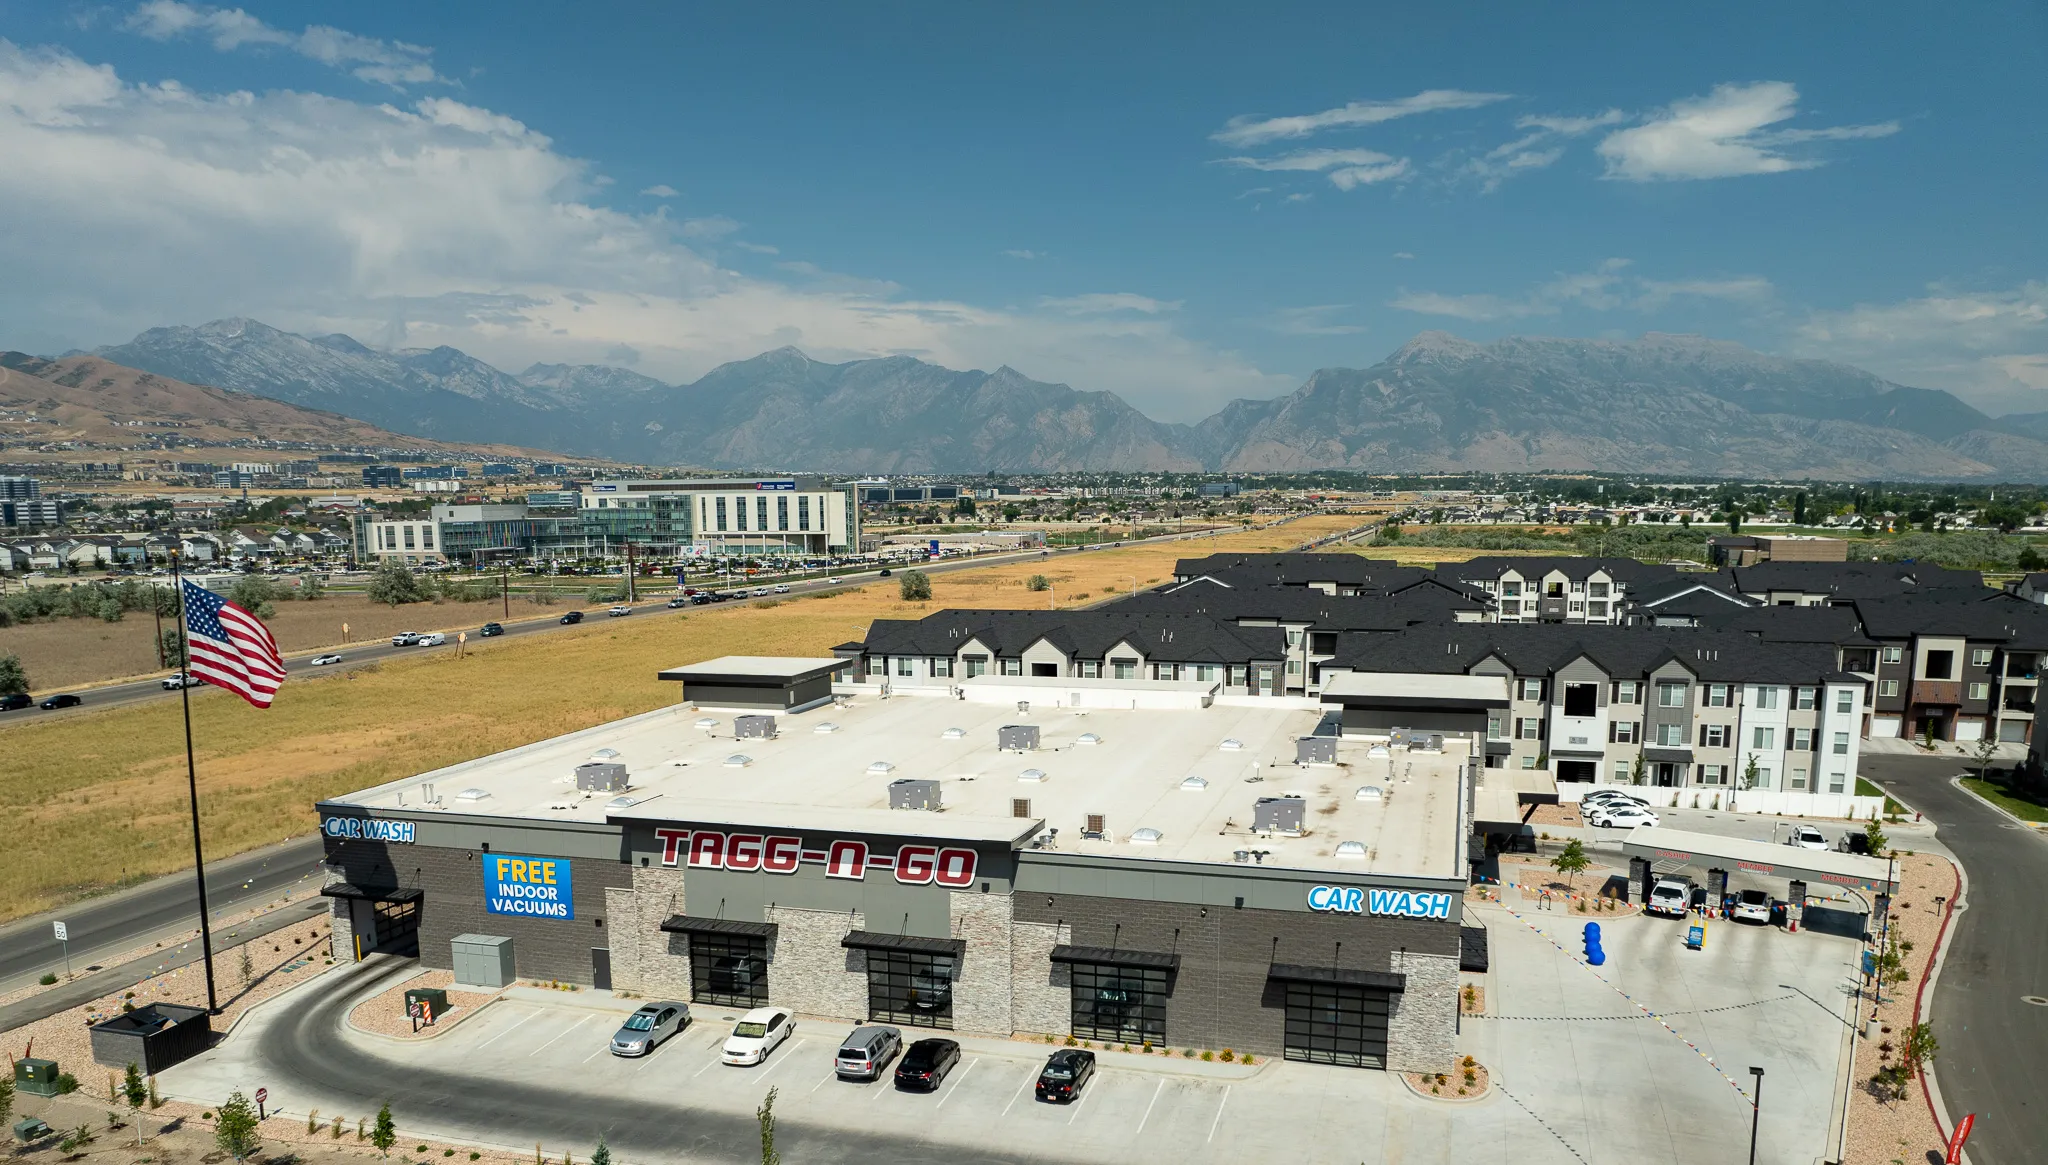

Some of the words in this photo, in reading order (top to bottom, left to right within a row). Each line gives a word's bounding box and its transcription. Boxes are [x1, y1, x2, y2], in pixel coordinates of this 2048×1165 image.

[326, 817, 361, 839] CAR
[362, 819, 416, 843] WASH
[655, 827, 979, 888] TAGG-N-GO
[1656, 850, 1692, 861] CASHIER
[497, 858, 557, 885] FREE
[1737, 861, 1774, 873] MEMBER
[1820, 874, 1860, 884] MEMBER
[499, 884, 558, 901] INDOOR
[493, 899, 567, 917] VACUUMS
[1308, 885, 1364, 914] CAR
[1369, 889, 1452, 919] WASH
